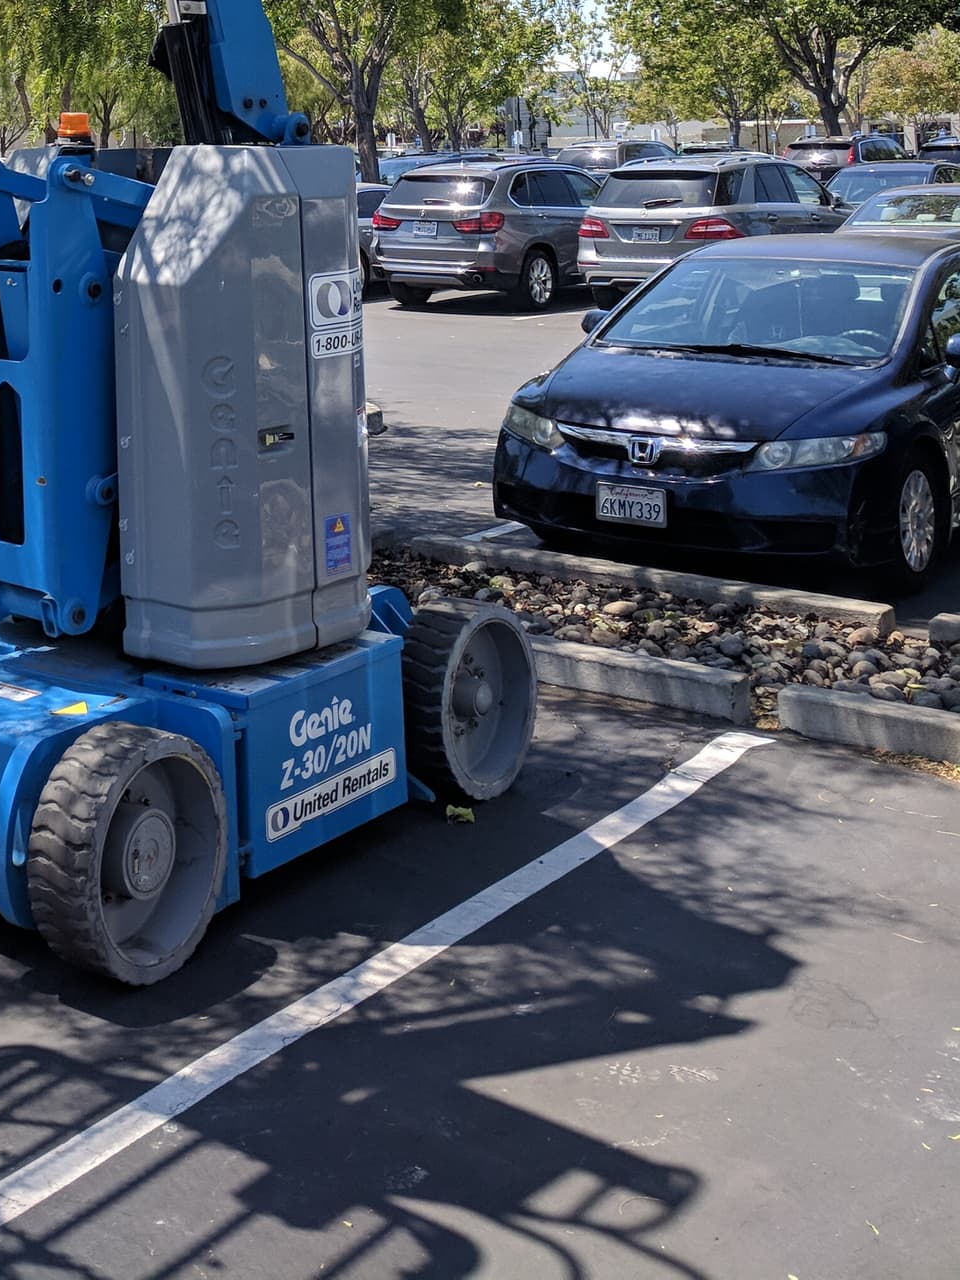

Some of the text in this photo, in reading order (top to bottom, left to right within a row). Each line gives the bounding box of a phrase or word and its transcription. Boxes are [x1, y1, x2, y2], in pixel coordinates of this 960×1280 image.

[601, 497, 661, 521] 6KMY339
[289, 695, 353, 747] Genie
[280, 722, 372, 791] Z-30/20N
[293, 759, 390, 822] United Rentals
